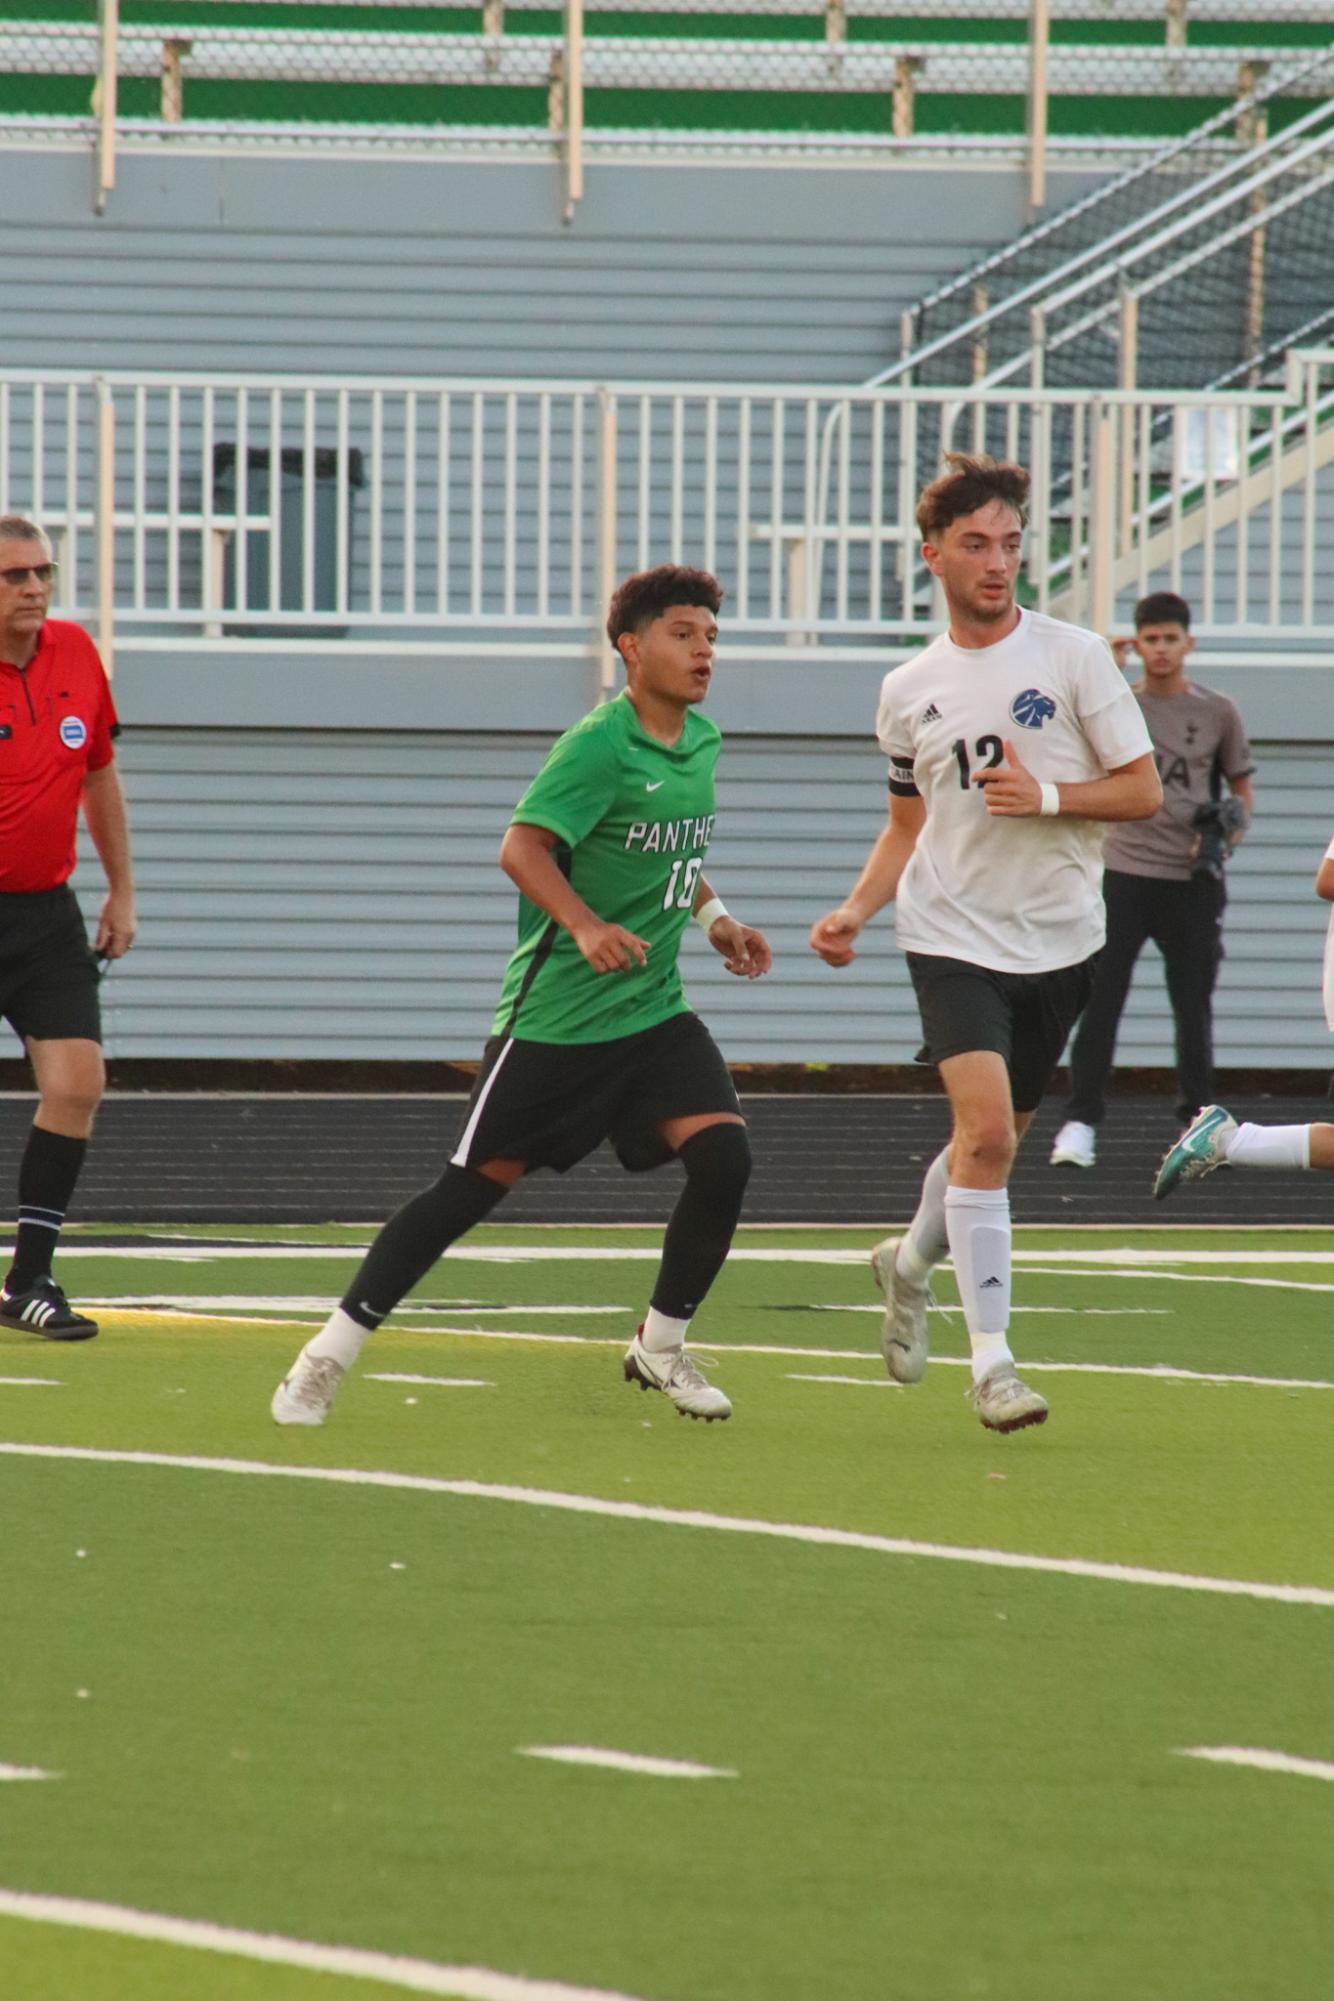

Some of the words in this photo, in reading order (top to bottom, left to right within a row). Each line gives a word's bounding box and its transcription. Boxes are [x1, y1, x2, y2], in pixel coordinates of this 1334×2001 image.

[952, 734, 1004, 790] 12
[625, 815, 714, 853] PANTHE
[663, 857, 702, 911] 10
